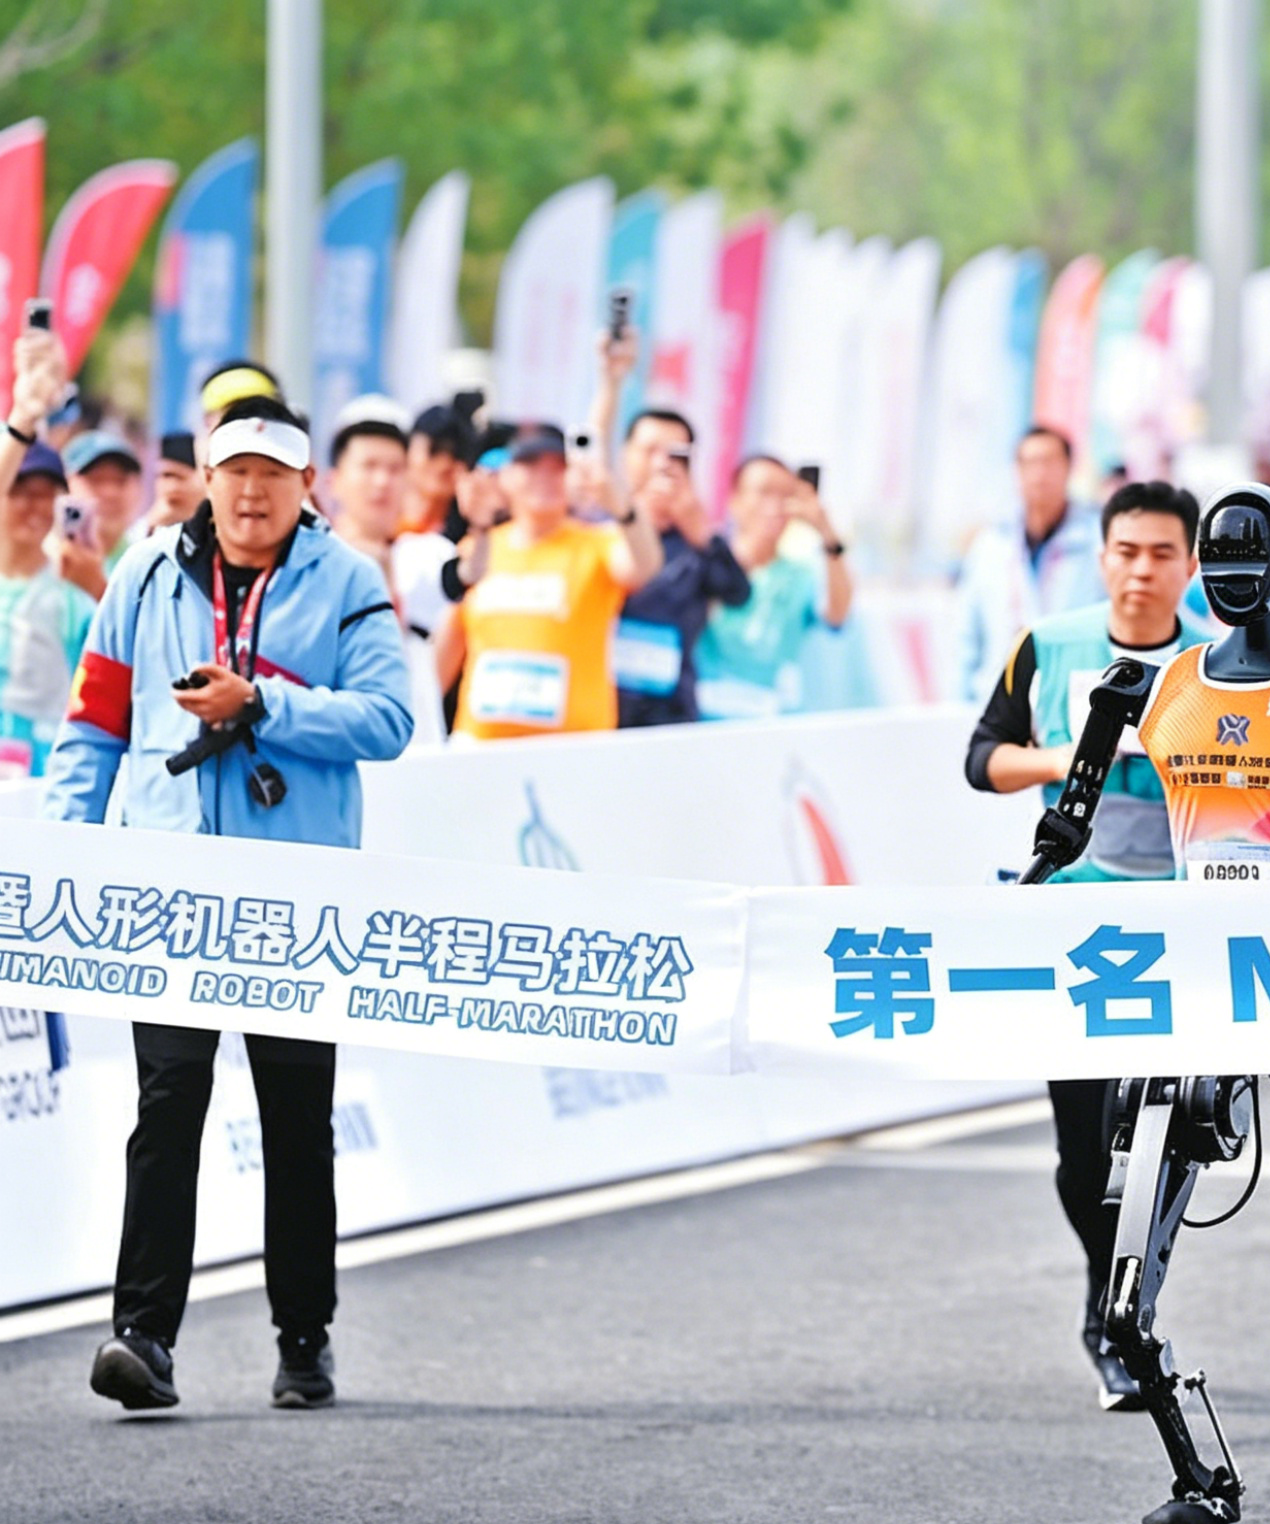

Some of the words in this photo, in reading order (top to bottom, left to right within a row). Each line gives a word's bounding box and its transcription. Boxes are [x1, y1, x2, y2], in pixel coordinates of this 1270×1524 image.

[189, 970, 324, 1014] ROBOT
[348, 986, 677, 1046] HALF-MARATHON
[823, 924, 1173, 1040] 第一名
